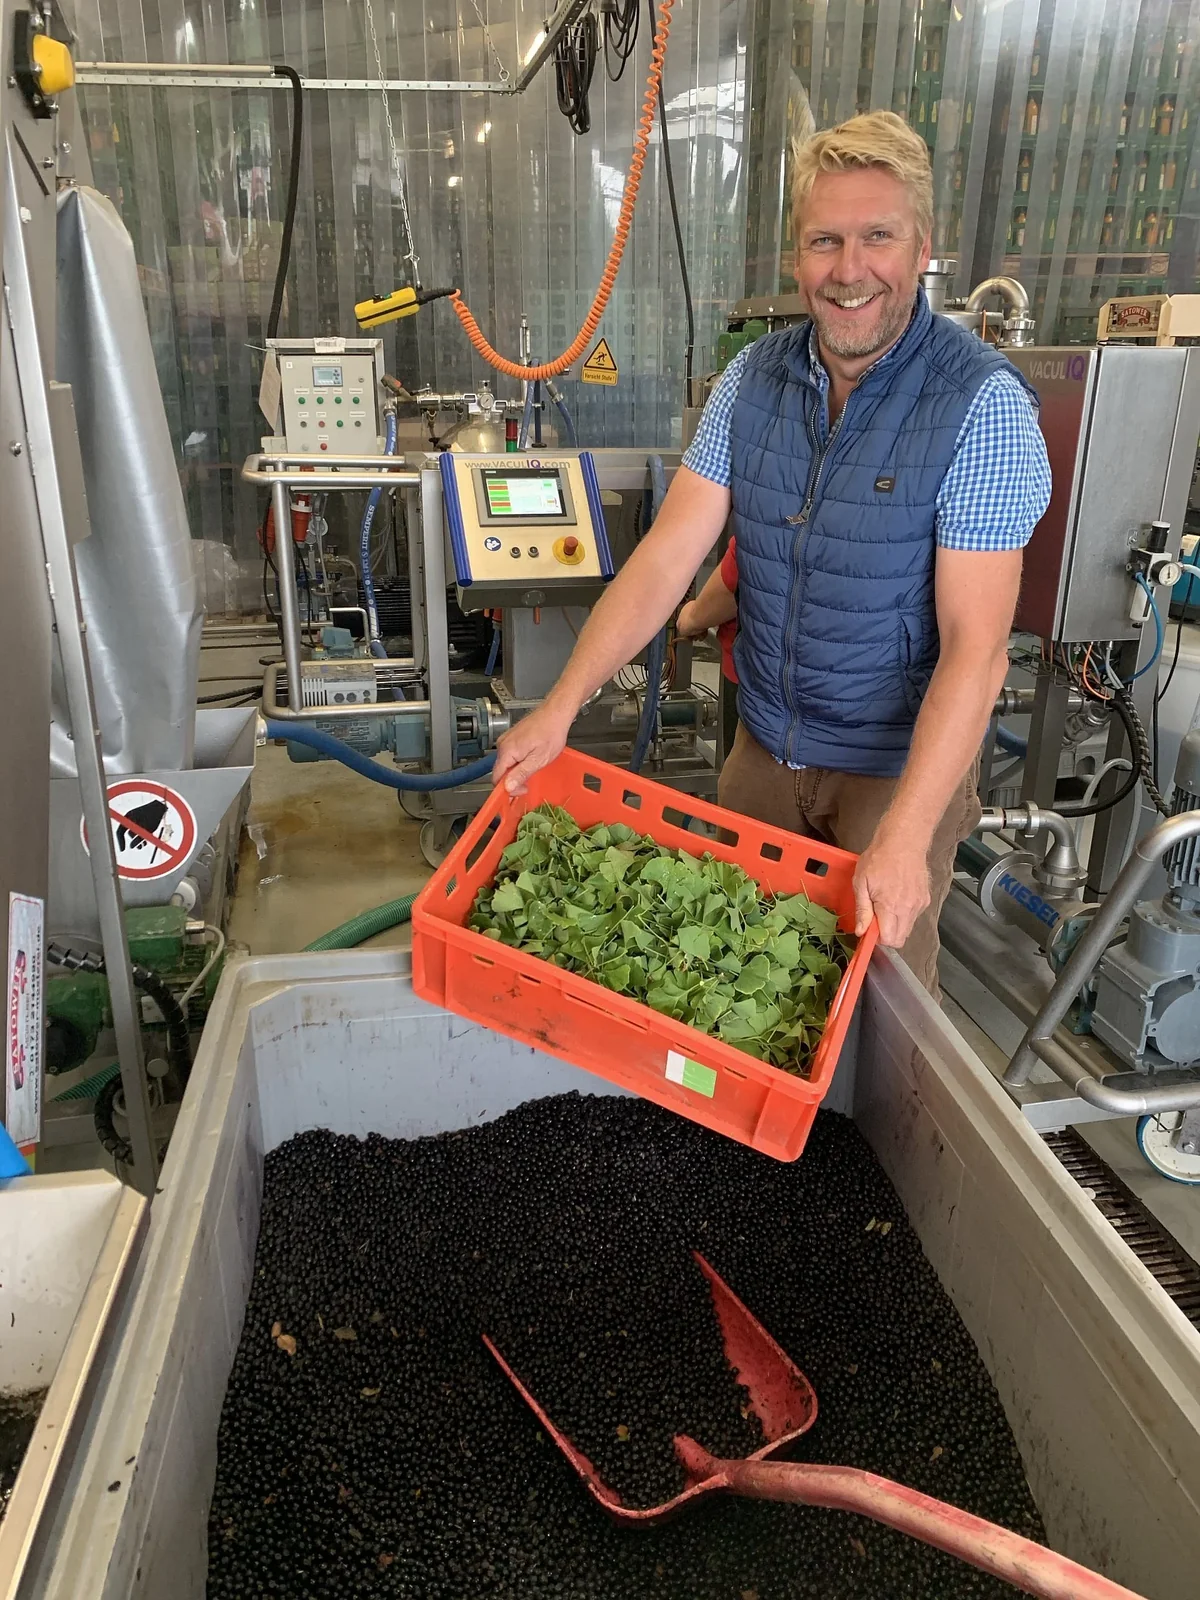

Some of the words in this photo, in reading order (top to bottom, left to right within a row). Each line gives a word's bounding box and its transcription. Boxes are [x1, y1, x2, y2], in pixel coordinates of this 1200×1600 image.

[1030, 355, 1085, 382] VACULIQ
[464, 459, 571, 469] www.VACULIQ.com
[362, 505, 375, 550] SEMPERIT
